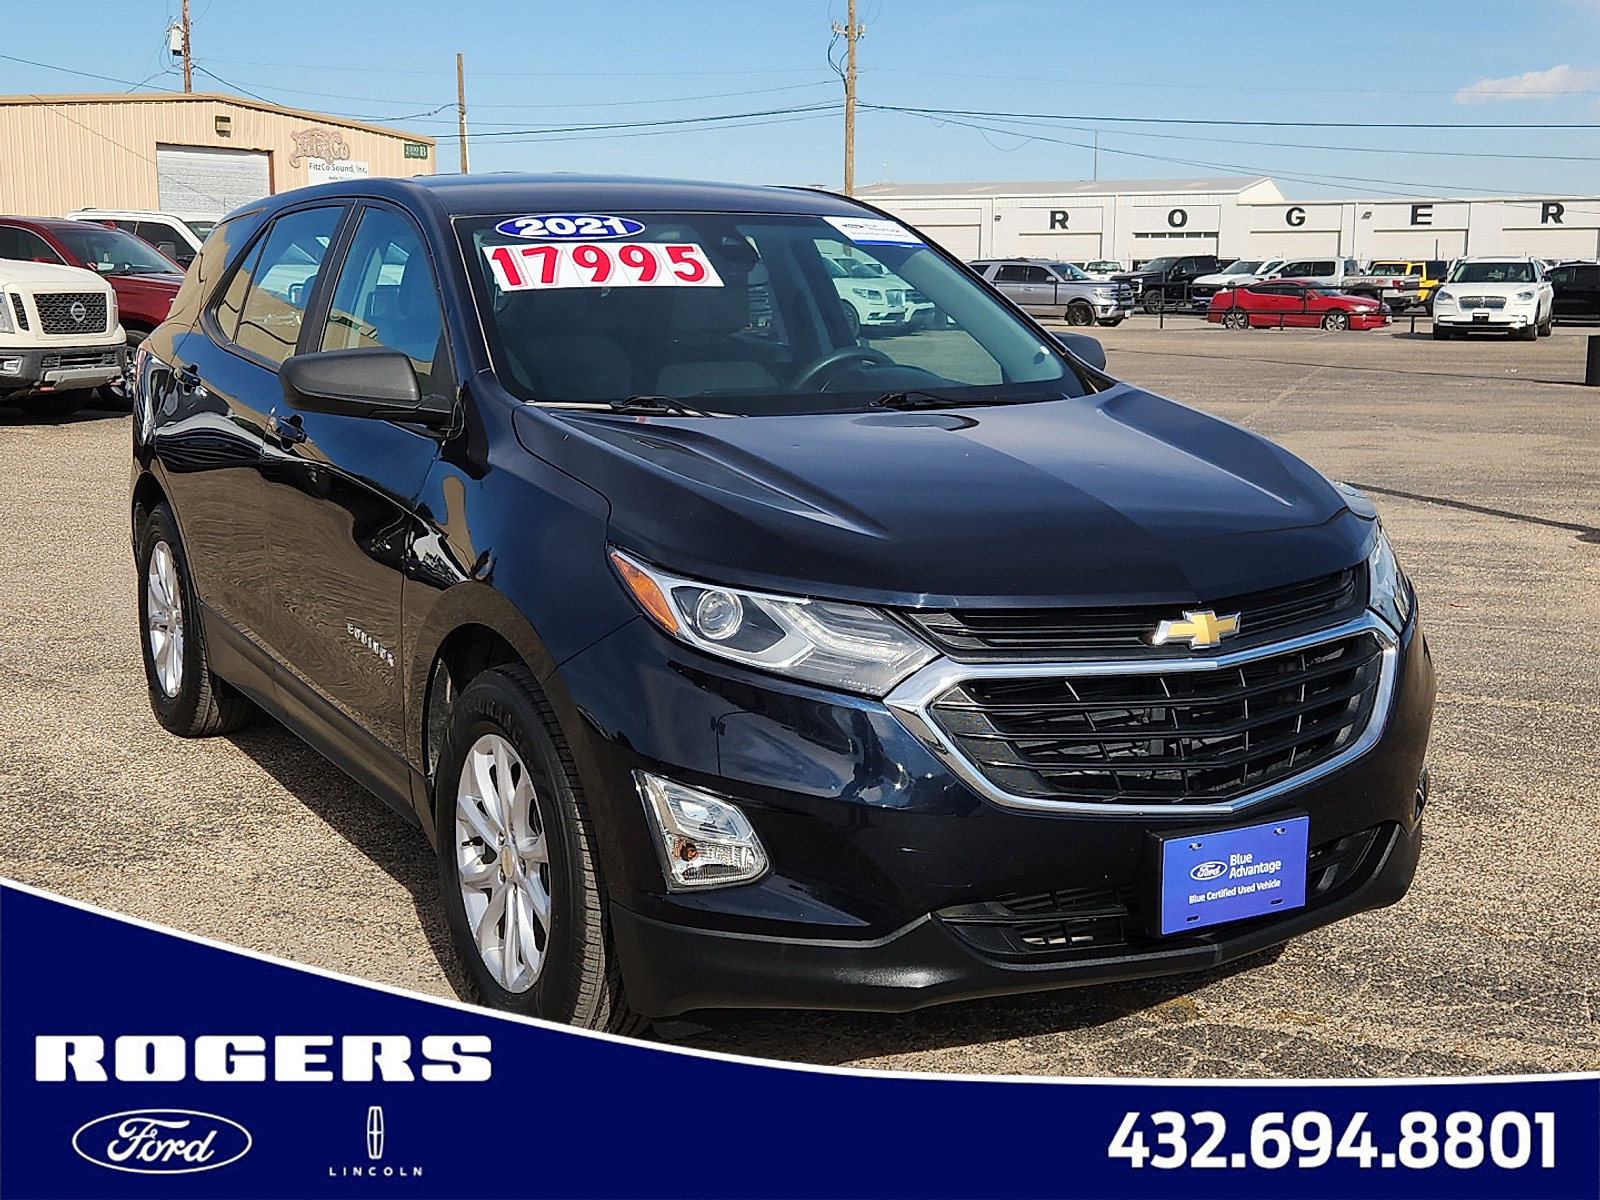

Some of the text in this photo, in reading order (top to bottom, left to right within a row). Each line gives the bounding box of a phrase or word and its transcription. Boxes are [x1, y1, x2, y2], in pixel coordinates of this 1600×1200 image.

[308, 162, 331, 171] FitzCo
[514, 217, 629, 236] 2021
[491, 244, 708, 287] 17995
[1229, 853, 1254, 867] Blue
[1196, 863, 1222, 878] Ford
[1228, 860, 1282, 880] Advantage
[1188, 878, 1282, 905] Blue Certified Used Vehicle
